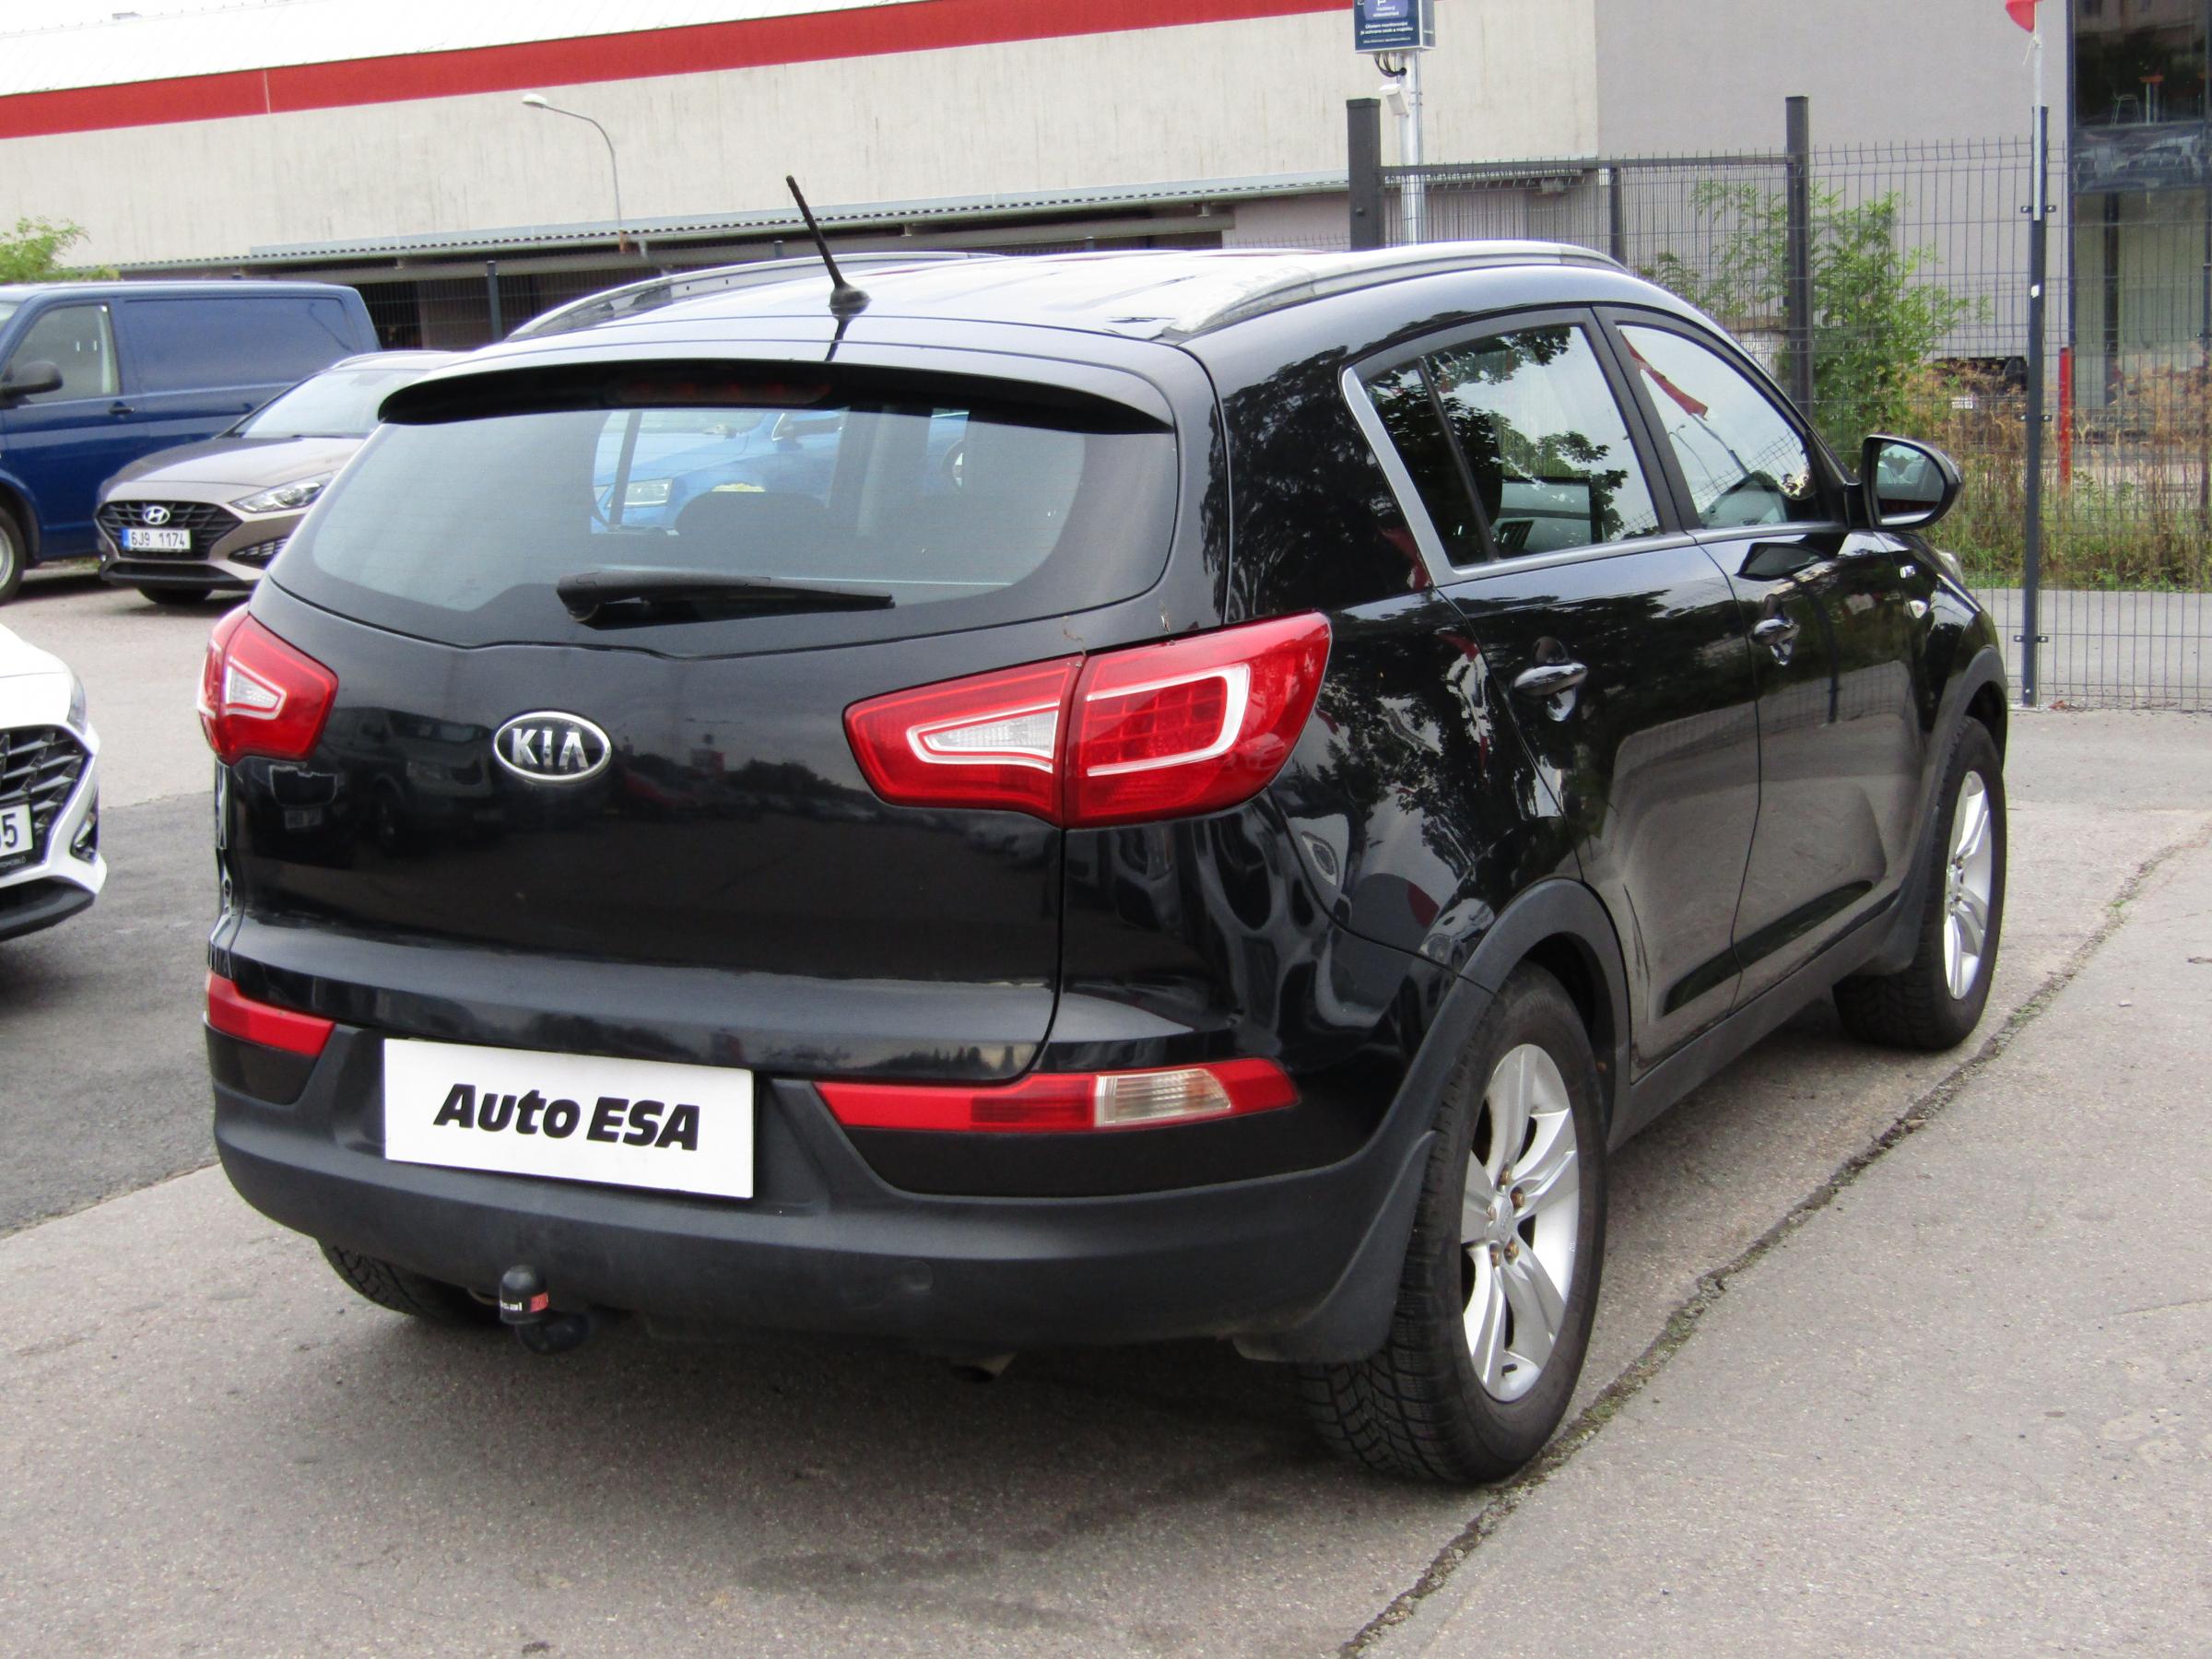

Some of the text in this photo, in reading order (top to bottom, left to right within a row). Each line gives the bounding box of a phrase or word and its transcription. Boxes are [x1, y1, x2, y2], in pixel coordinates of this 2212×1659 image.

[131, 532, 186, 547] 6J9 1174
[511, 726, 590, 768] KIA
[433, 1082, 700, 1152] Auto ESA
